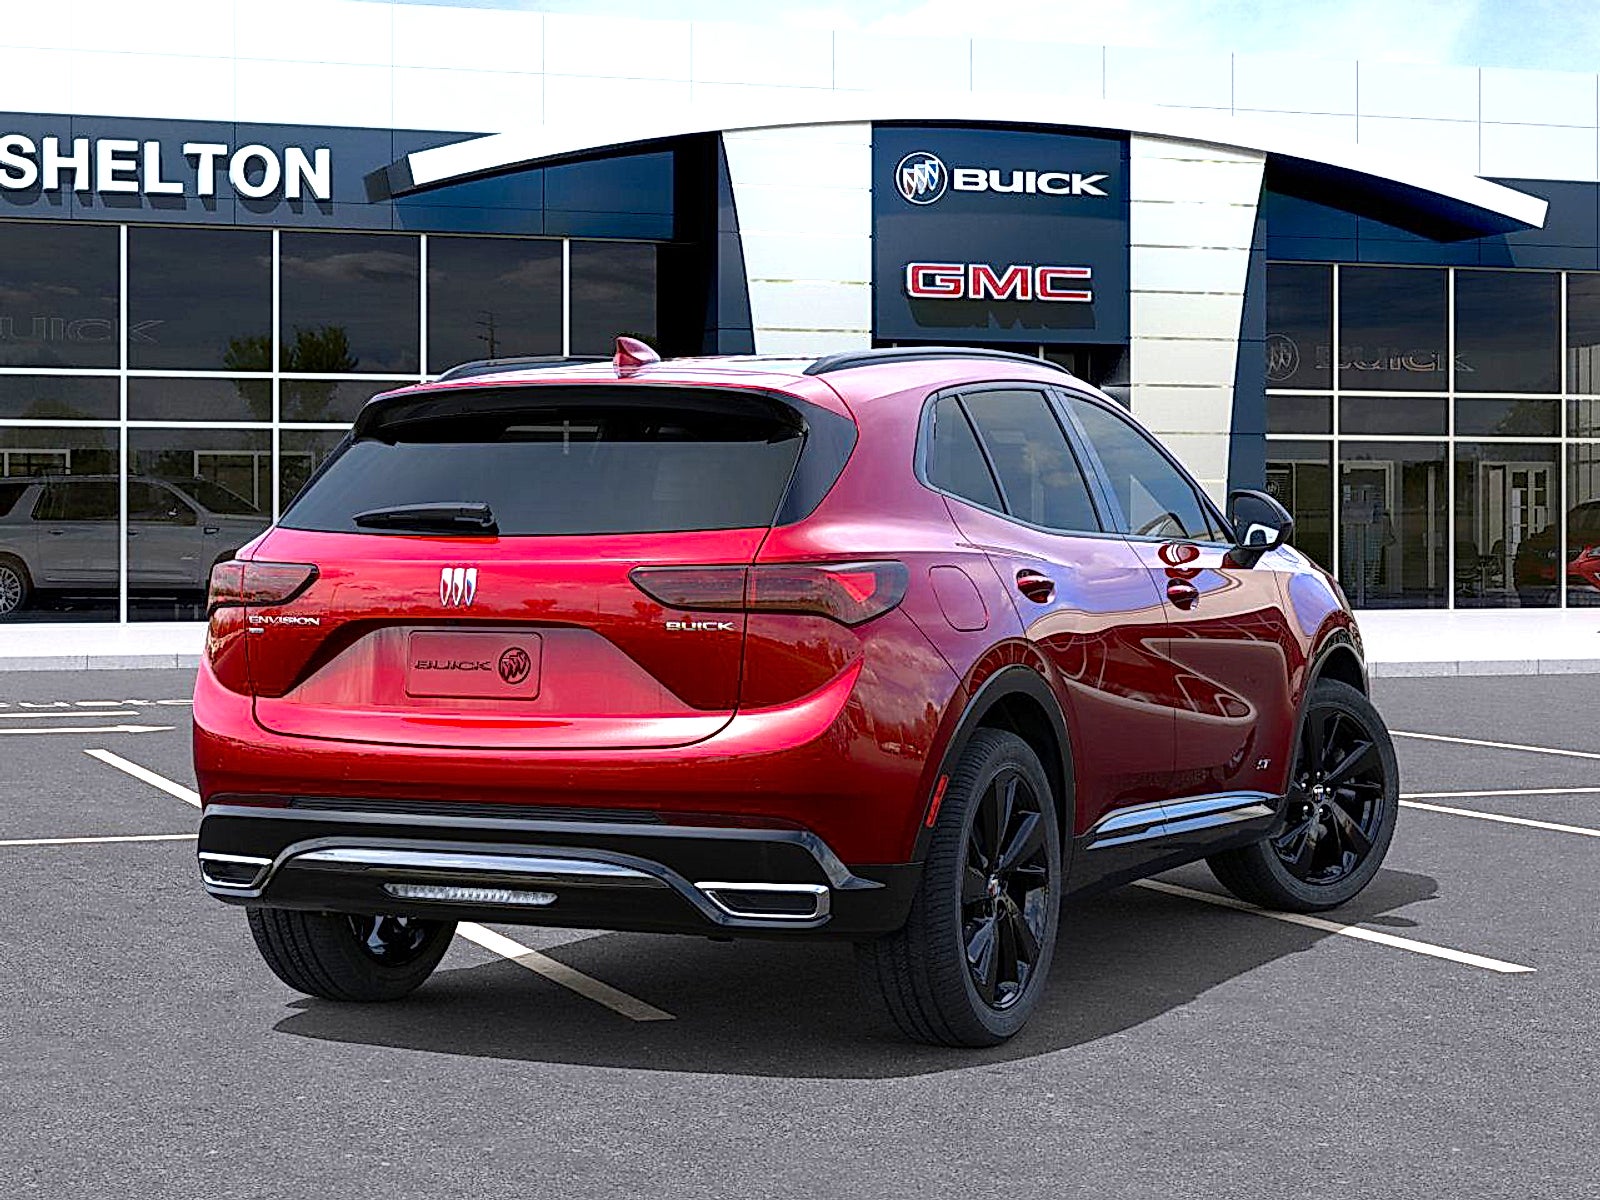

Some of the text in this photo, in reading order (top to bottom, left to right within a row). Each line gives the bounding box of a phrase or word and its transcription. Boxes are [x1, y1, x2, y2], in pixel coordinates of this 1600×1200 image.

[0, 134, 331, 200] SHELTON
[953, 168, 1109, 197] BUICK
[906, 262, 1092, 302] GMC
[248, 615, 320, 626] ENVISION
[665, 621, 735, 632] BUICK
[414, 659, 493, 671] BUICK
